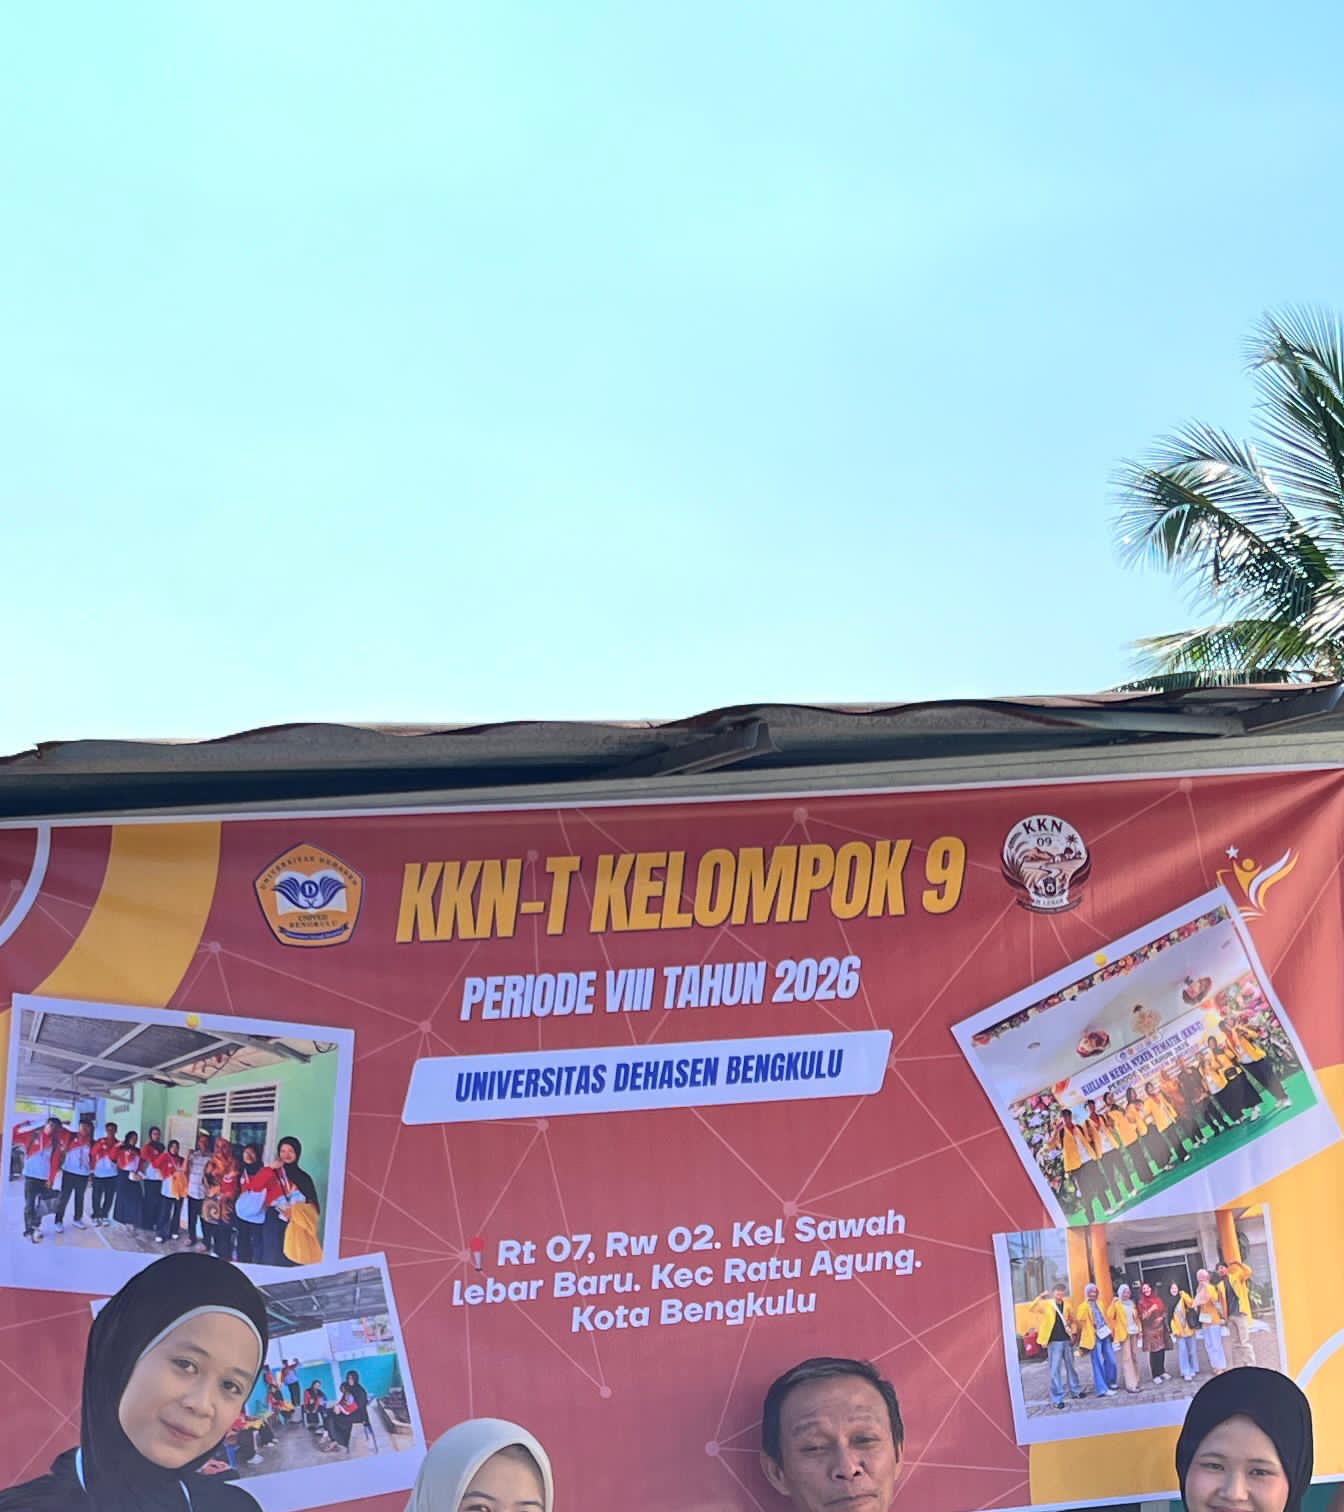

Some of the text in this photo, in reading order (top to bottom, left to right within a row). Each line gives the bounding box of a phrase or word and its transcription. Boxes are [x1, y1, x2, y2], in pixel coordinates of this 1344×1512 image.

[1022, 818, 1063, 834] KKN
[1036, 836, 1052, 847] 09
[395, 836, 967, 944] KKN-T KELOMPOK 9
[460, 955, 862, 1022] PERIODE VIII TAHUN 2026
[455, 1048, 844, 1103] UNIVERSITAS DEHASEN BENGKULU
[497, 1239, 537, 1266] Rt
[606, 1231, 658, 1258] Rw
[731, 1219, 785, 1248] Kel
[794, 1209, 906, 1243] Sawah
[553, 1271, 641, 1298] Baru.
[651, 1263, 714, 1290] Kec
[723, 1256, 802, 1284] Ratu
[809, 1248, 923, 1281] Agung.
[571, 1288, 817, 1333] Kota Bengkulu
